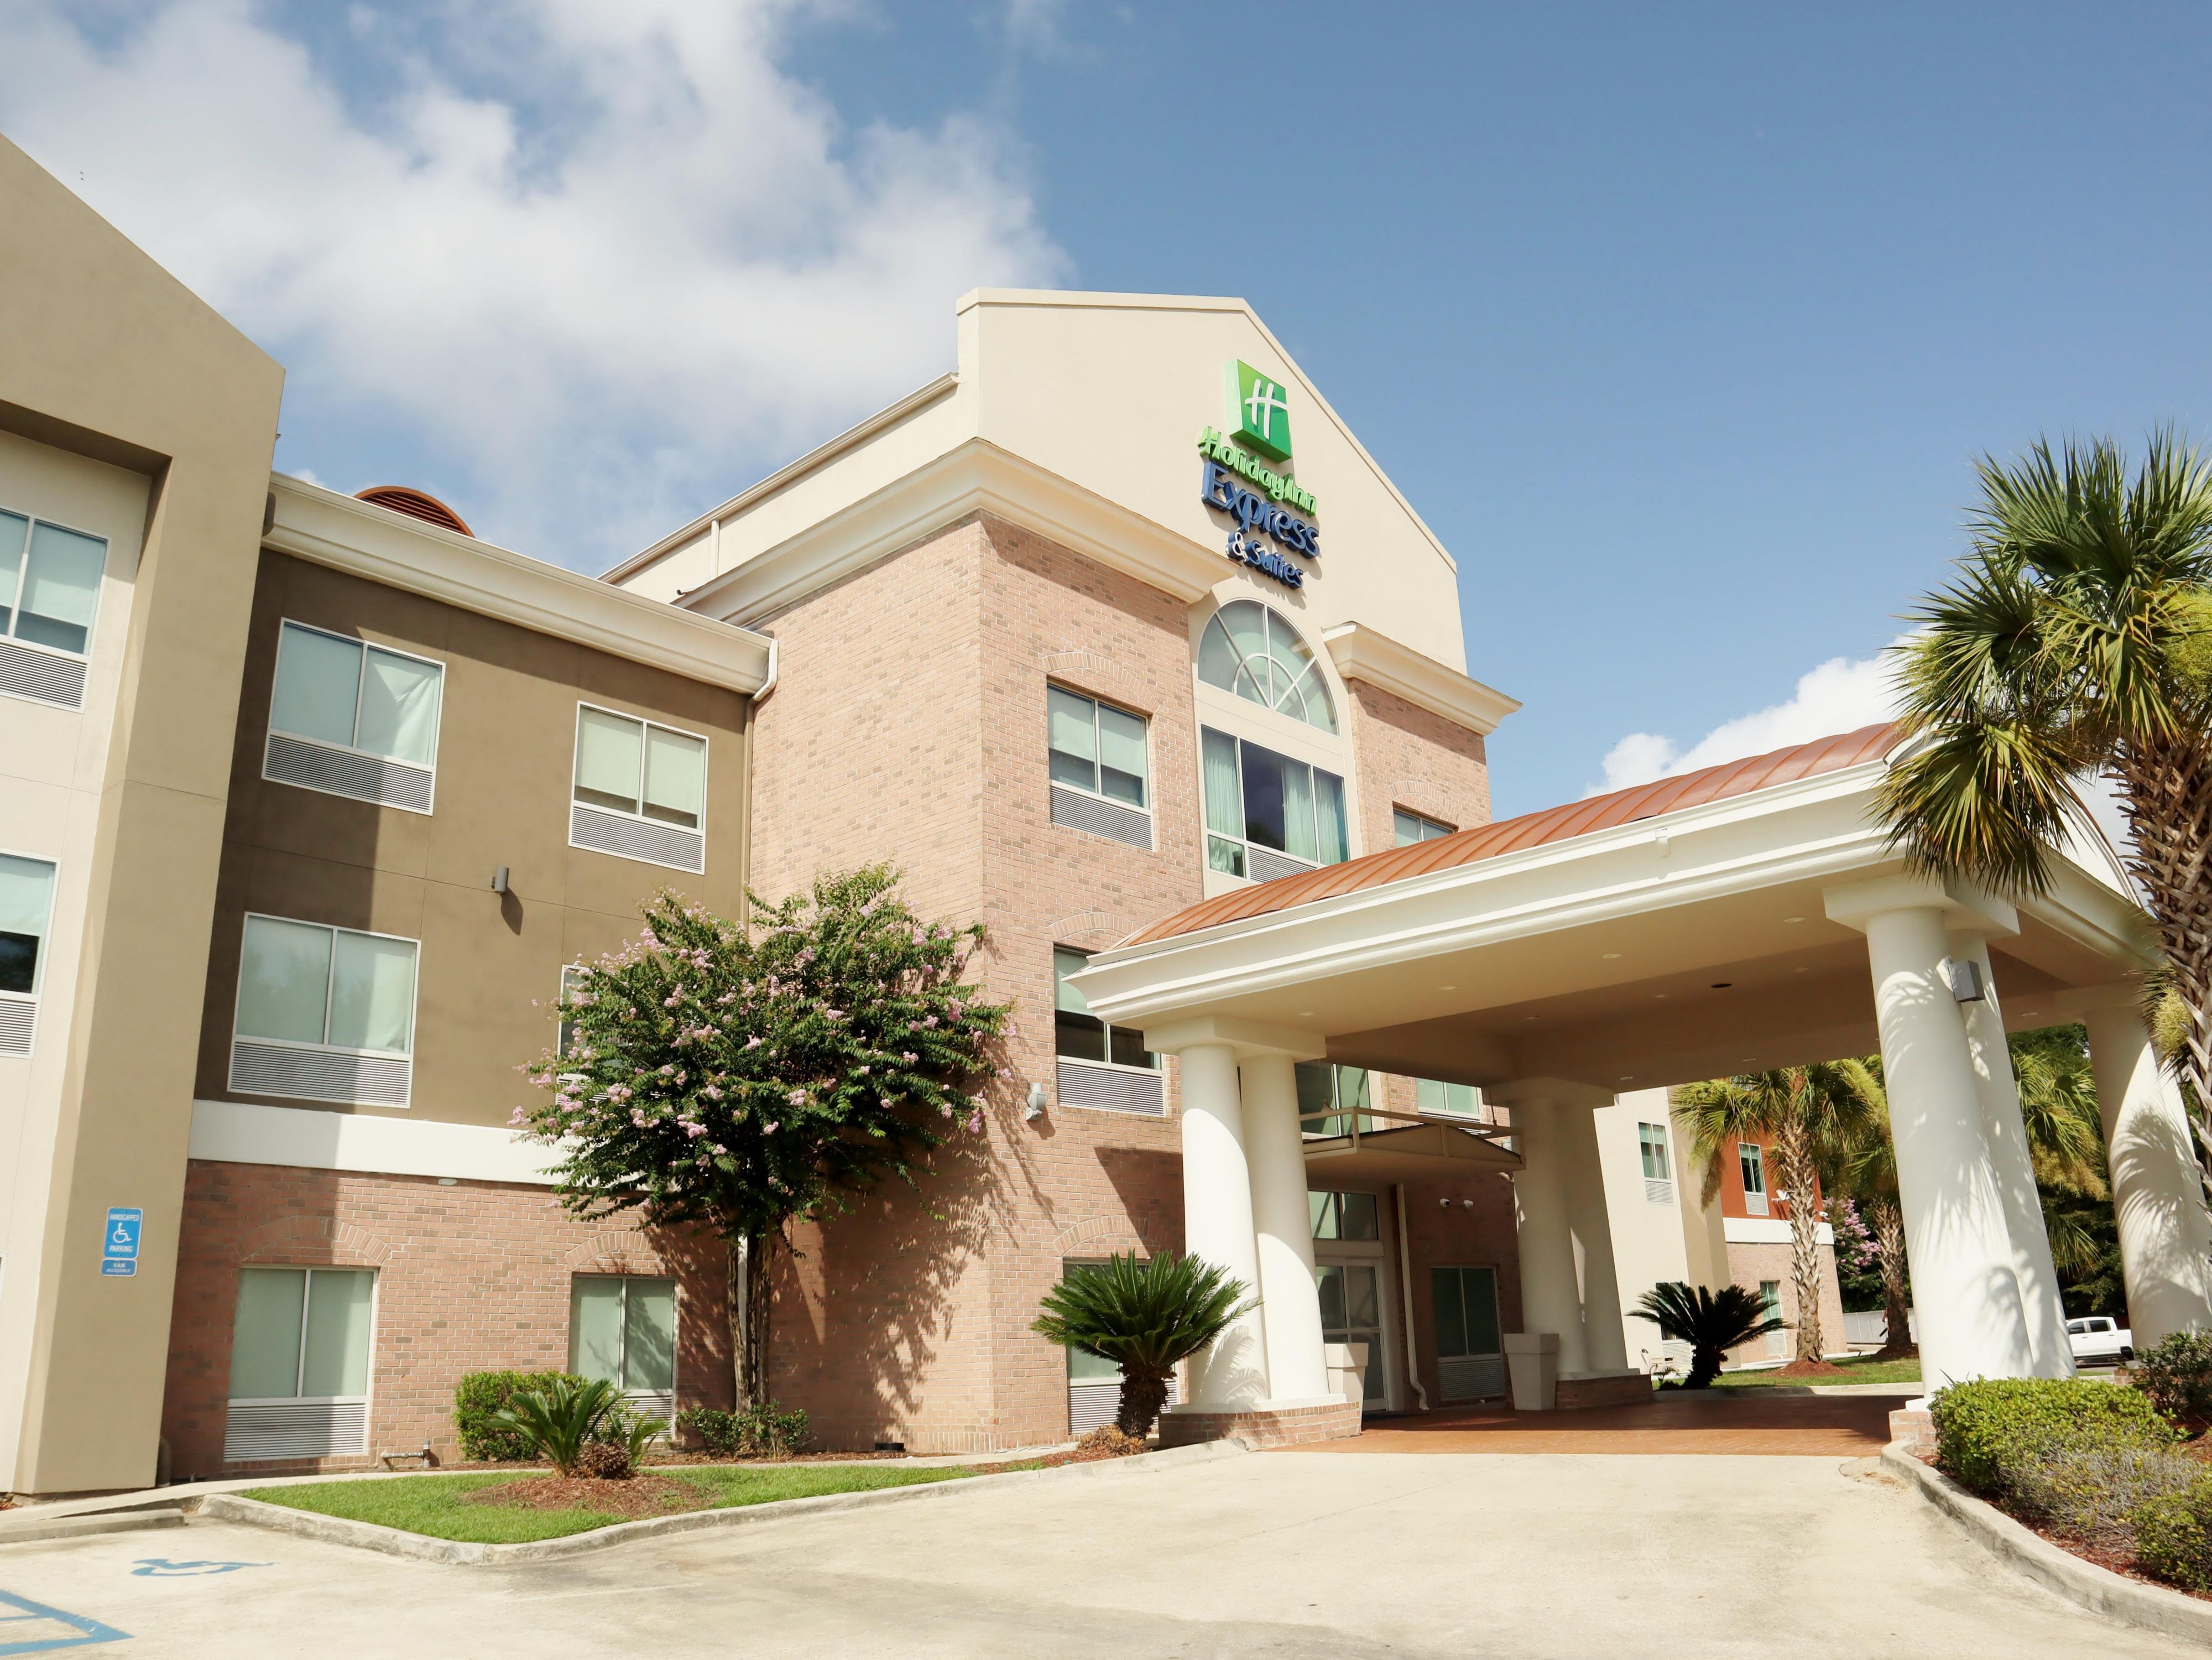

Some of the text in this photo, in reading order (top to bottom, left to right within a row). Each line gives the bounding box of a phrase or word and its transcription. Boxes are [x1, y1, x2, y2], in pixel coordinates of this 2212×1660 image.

[1202, 461, 1320, 559] Express
[1225, 531, 1304, 589] & Suites
[109, 1245, 133, 1253] PARKING
